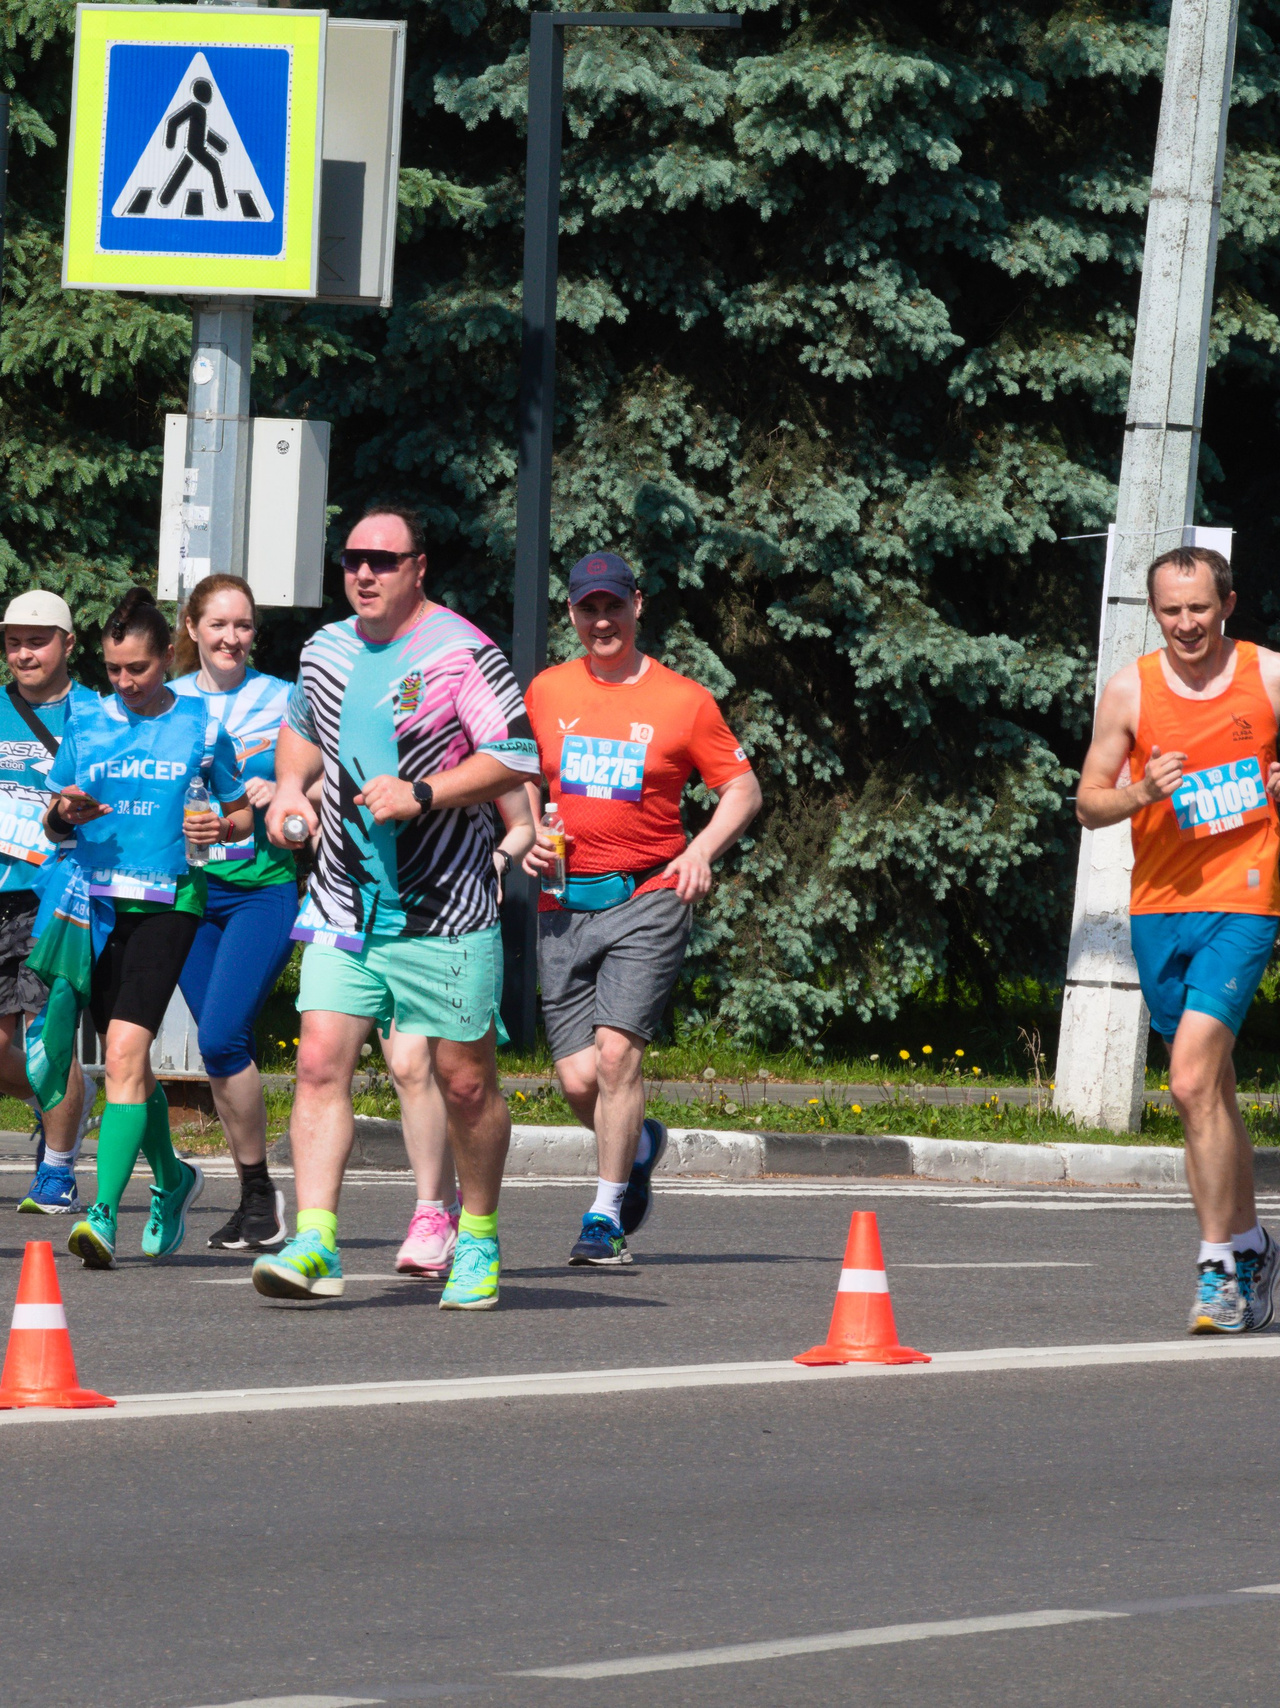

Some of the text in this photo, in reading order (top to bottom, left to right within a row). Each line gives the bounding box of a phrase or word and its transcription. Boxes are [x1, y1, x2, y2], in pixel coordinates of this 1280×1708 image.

[628, 722, 654, 744] 10
[89, 755, 187, 782] ПЕЙСЕР
[565, 751, 638, 788] 50275
[585, 783, 613, 800] 10KM
[1179, 776, 1260, 824] 70109
[1207, 812, 1245, 836] 21.1KM
